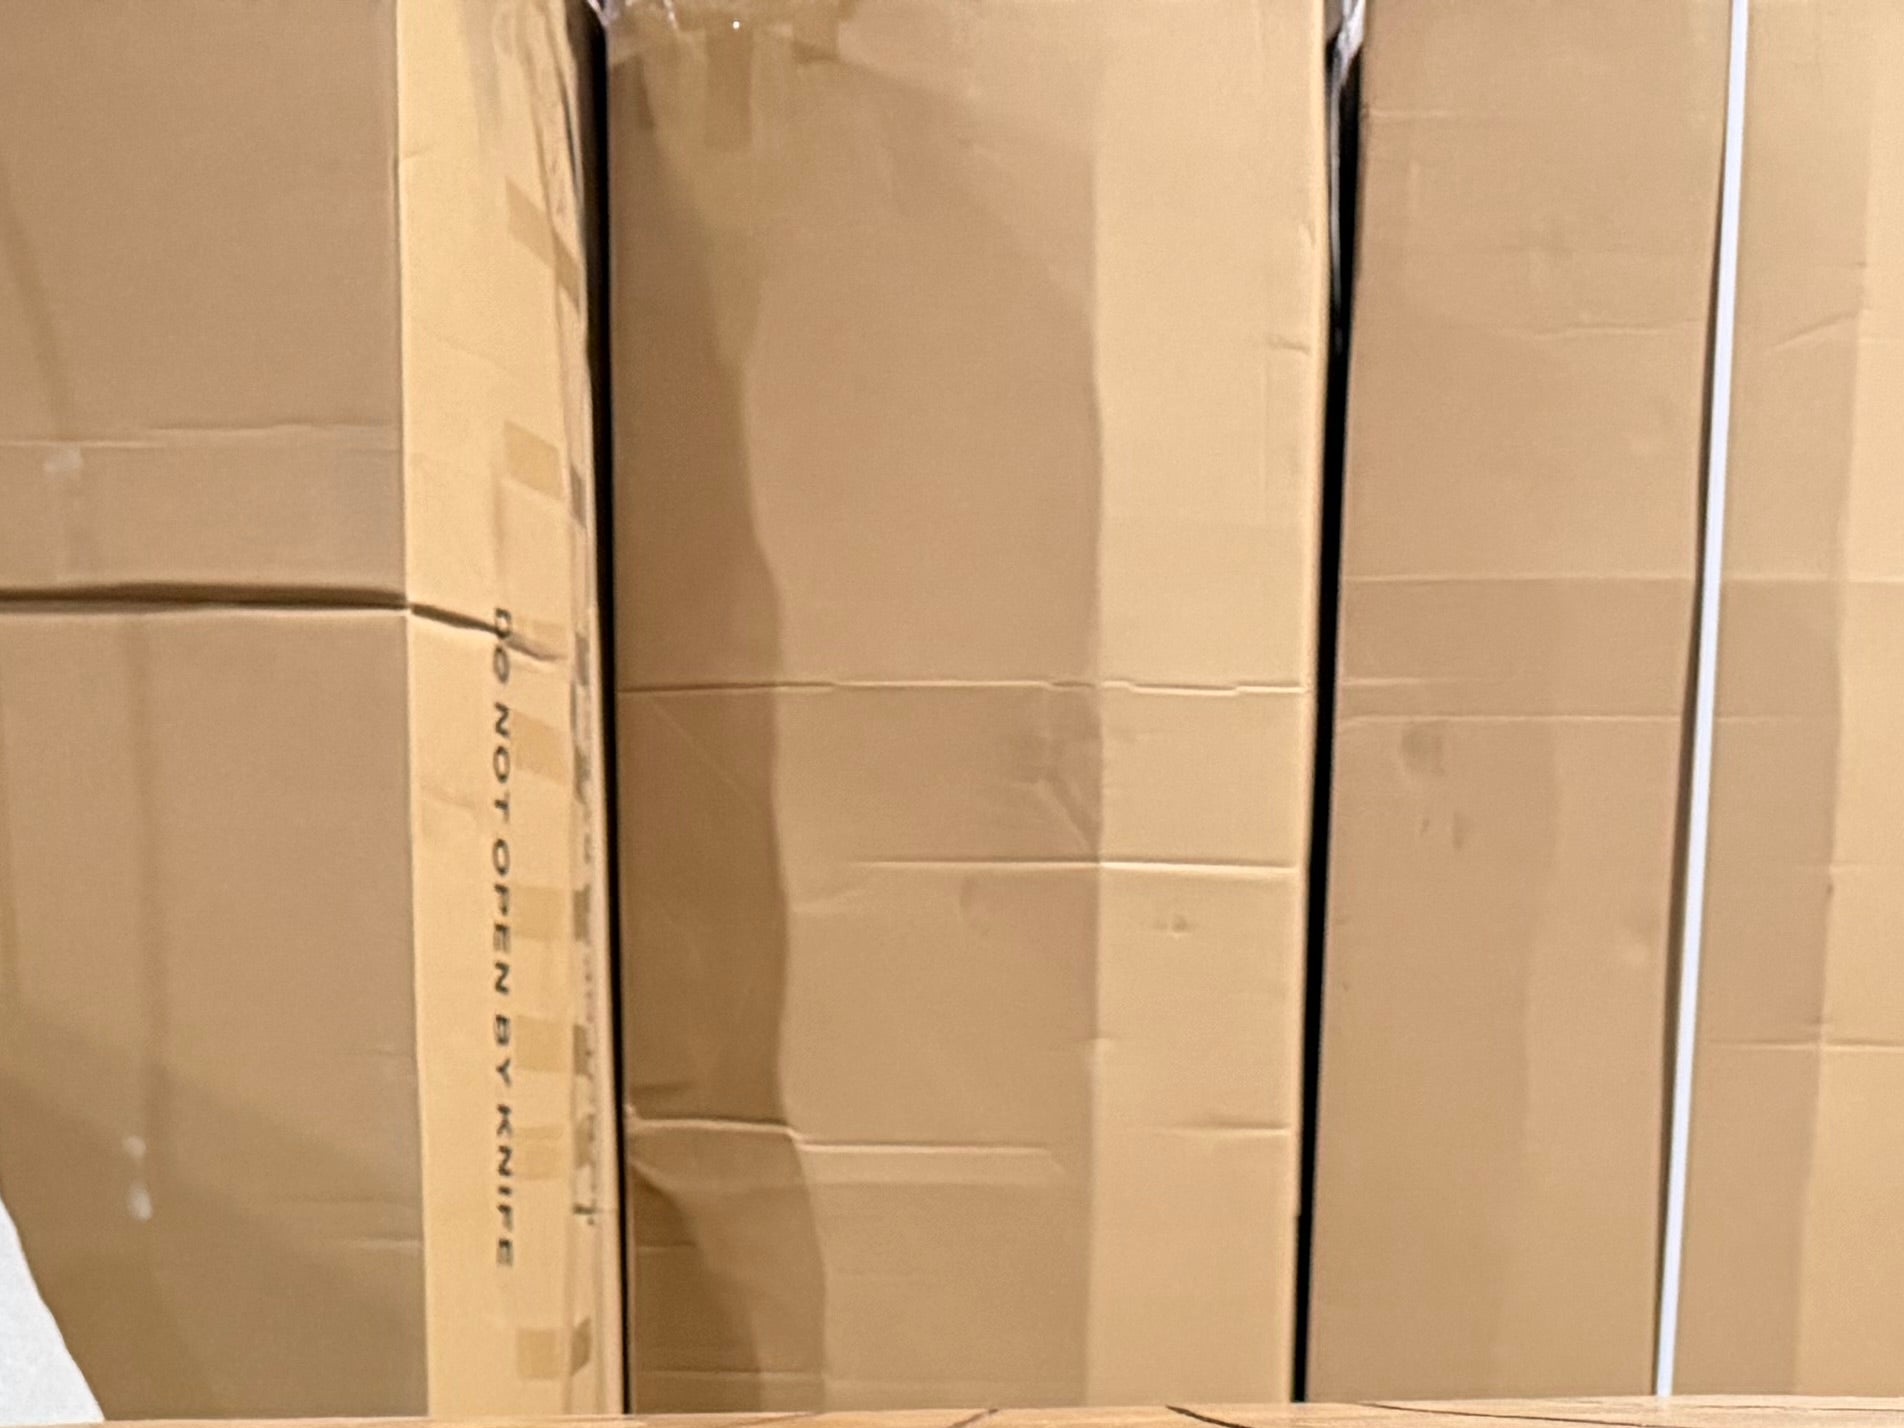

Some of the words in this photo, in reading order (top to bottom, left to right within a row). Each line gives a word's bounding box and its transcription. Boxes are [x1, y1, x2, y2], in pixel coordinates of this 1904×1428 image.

[493, 608, 511, 683] DO
[493, 702, 511, 823] NOT
[492, 838, 511, 995] OPEN
[493, 1014, 511, 1087] BY
[496, 1104, 514, 1266] KNIFE
